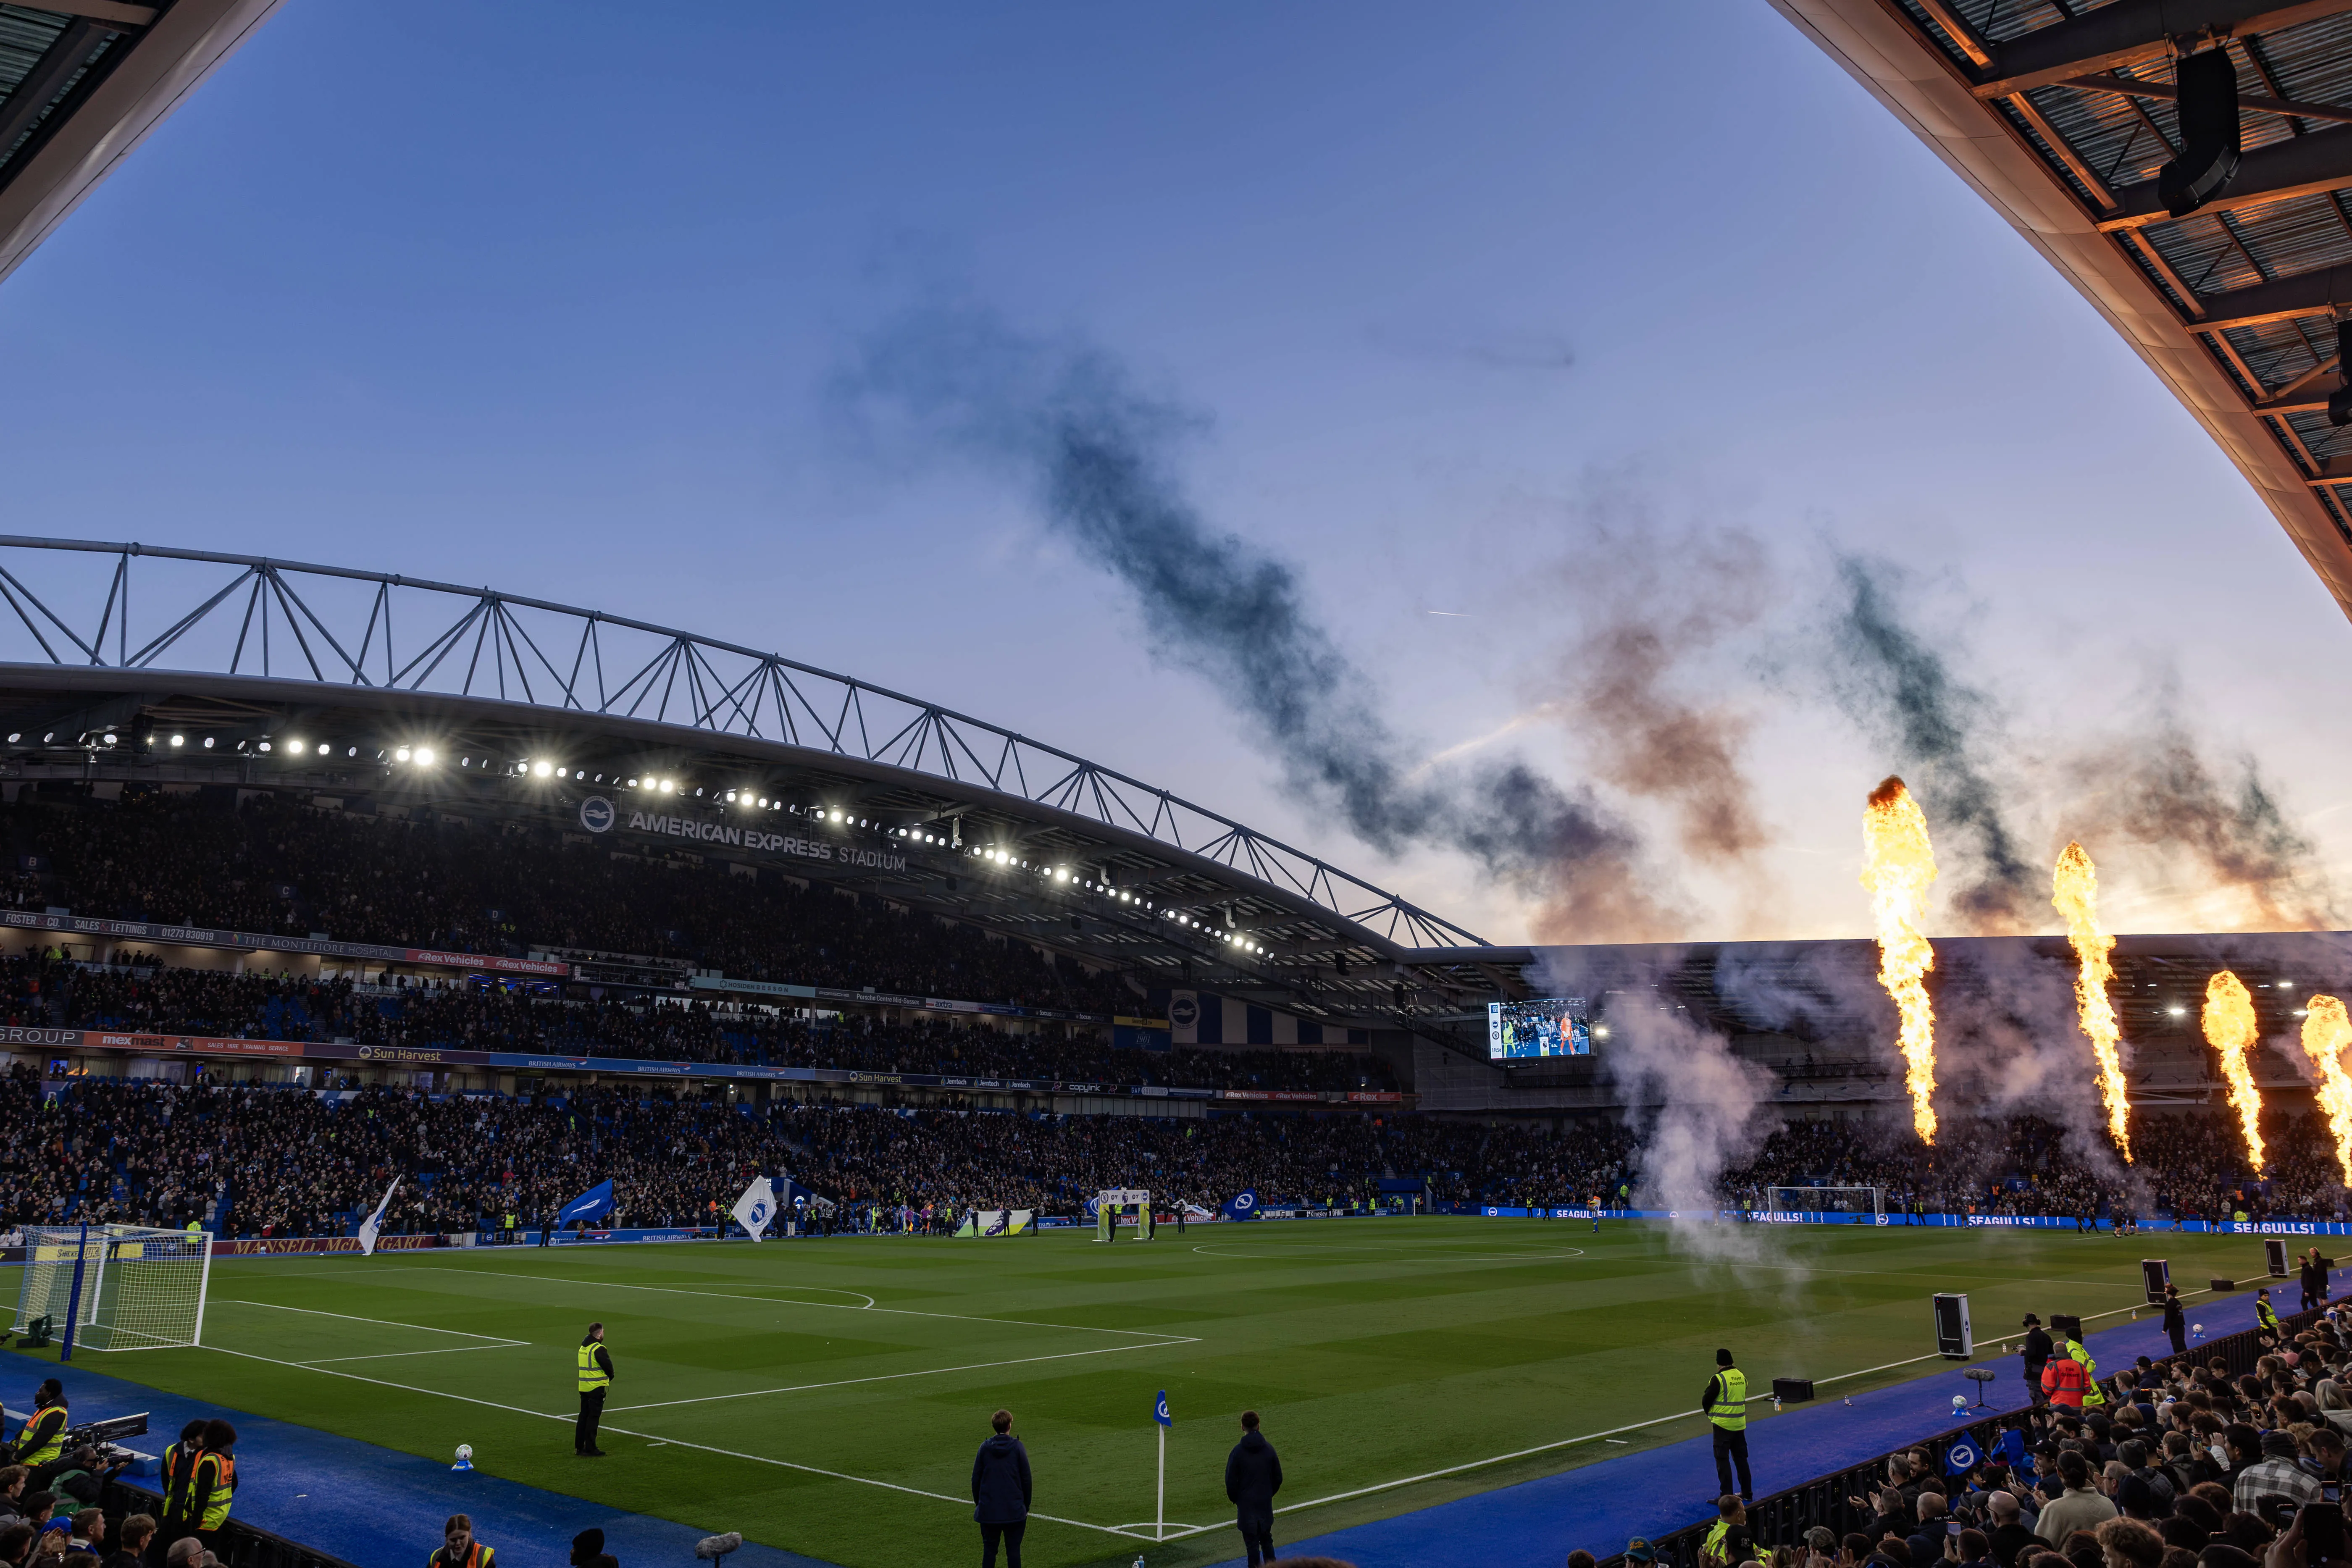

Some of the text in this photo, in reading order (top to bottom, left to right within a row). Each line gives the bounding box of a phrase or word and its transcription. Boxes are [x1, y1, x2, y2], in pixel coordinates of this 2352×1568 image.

[629, 812, 906, 872] AMERICAN EXPRESS STADIUM
[28, 857, 37, 867] B
[282, 886, 290, 896] C
[5, 913, 37, 925] FOSTER
[47, 917, 60, 927] CO.
[74, 919, 100, 931] SALES
[111, 923, 147, 935] LETTINGS
[161, 927, 184, 938] 01273
[185, 929, 214, 941] 830919
[244, 935, 394, 958] THE MONTEFIORE HOSPITAL
[424, 953, 557, 973] Rex Vehicles Rex Vehicles
[856, 993, 876, 1001] Porsche
[893, 996, 920, 1006] Mid-Sussex
[102, 1035, 166, 1046] mexmast
[1137, 1035, 1151, 1043] 1901
[373, 1048, 441, 1061] Sun Harvest
[874, 1074, 902, 1084] Harvest
[1069, 1084, 1101, 1093] copylink
[1556, 1210, 1607, 1219] SEAGULS!
[2233, 1222, 2315, 1234] SEAGULLS!
[232, 1239, 321, 1255] MANSELL
